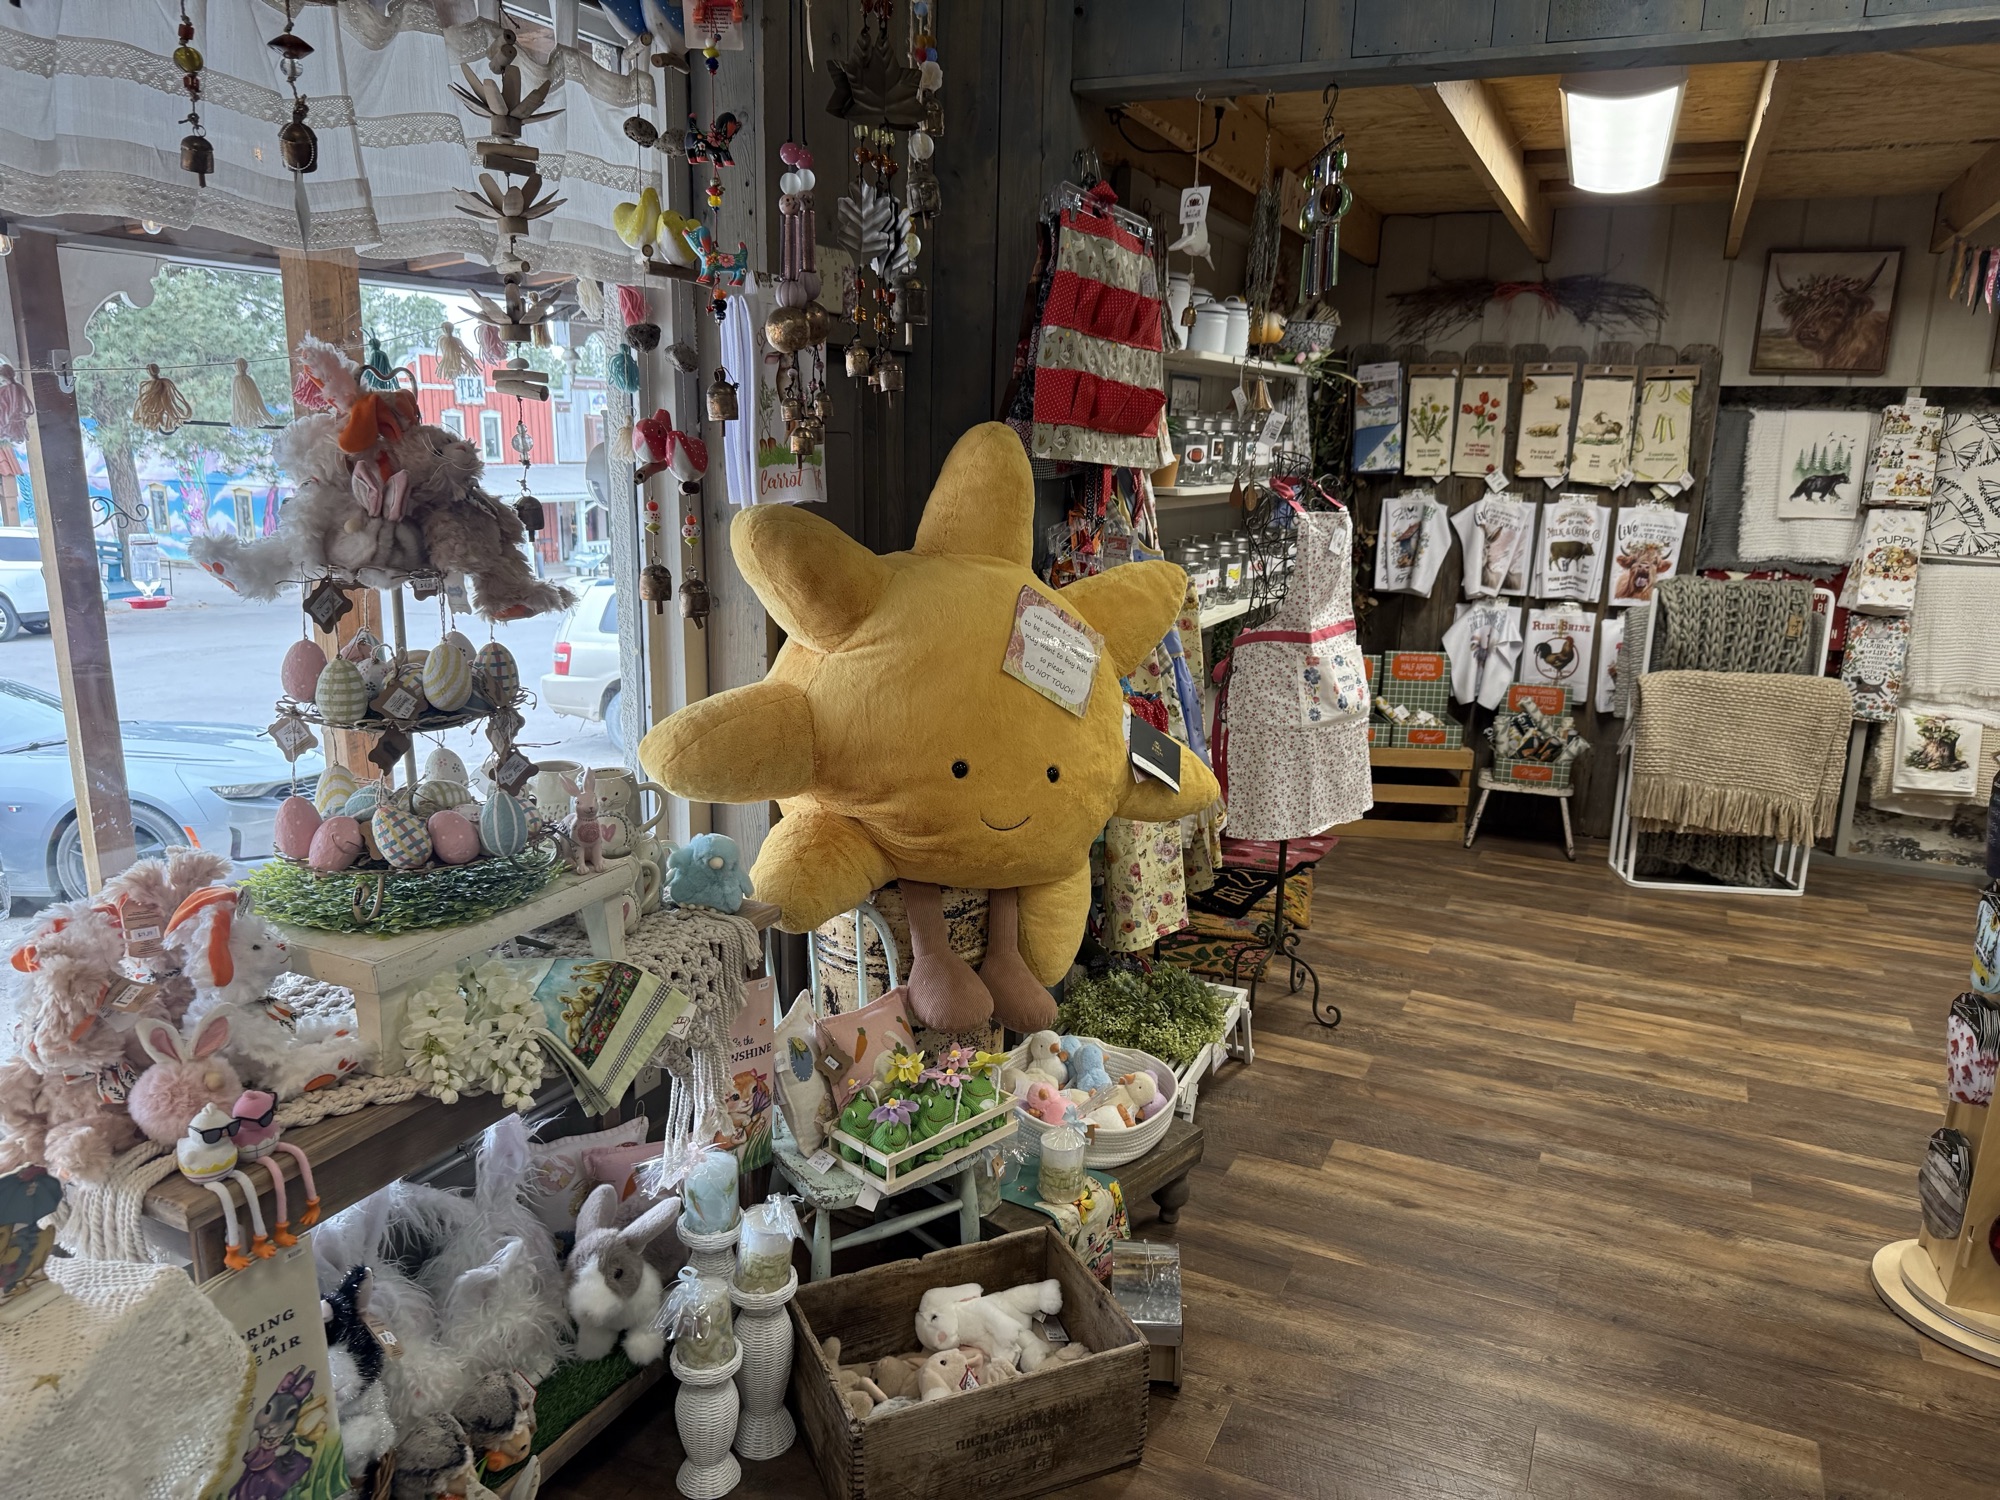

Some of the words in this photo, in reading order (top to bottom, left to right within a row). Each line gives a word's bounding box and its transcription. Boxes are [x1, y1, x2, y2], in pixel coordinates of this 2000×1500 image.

[458, 378, 484, 400] TEA
[760, 468, 813, 495] Carrot
[1618, 520, 1638, 540] Live
[1877, 535, 1918, 547] PUPPY
[1033, 624, 1040, 633] be
[1034, 612, 1043, 622] We
[1045, 620, 1061, 632] want
[1074, 636, 1086, 647] Sun
[1532, 621, 1555, 631] RISE
[1562, 621, 1591, 632] SHINE
[1025, 633, 1038, 646] may
[1040, 643, 1055, 655] want
[1057, 652, 1064, 660] to
[1065, 656, 1075, 669] buy
[1076, 663, 1088, 675] him
[1048, 661, 1066, 676] please
[1416, 663, 1435, 671] APRON
[1025, 661, 1035, 672] DO
[1036, 668, 1051, 680] NOT
[1053, 678, 1076, 695] TOUCH!
[743, 1035, 754, 1045] the
[731, 1042, 772, 1063] NSHINE
[241, 1308, 295, 1341] RING
[262, 1335, 277, 1347] in
[268, 1336, 302, 1360] AIR
